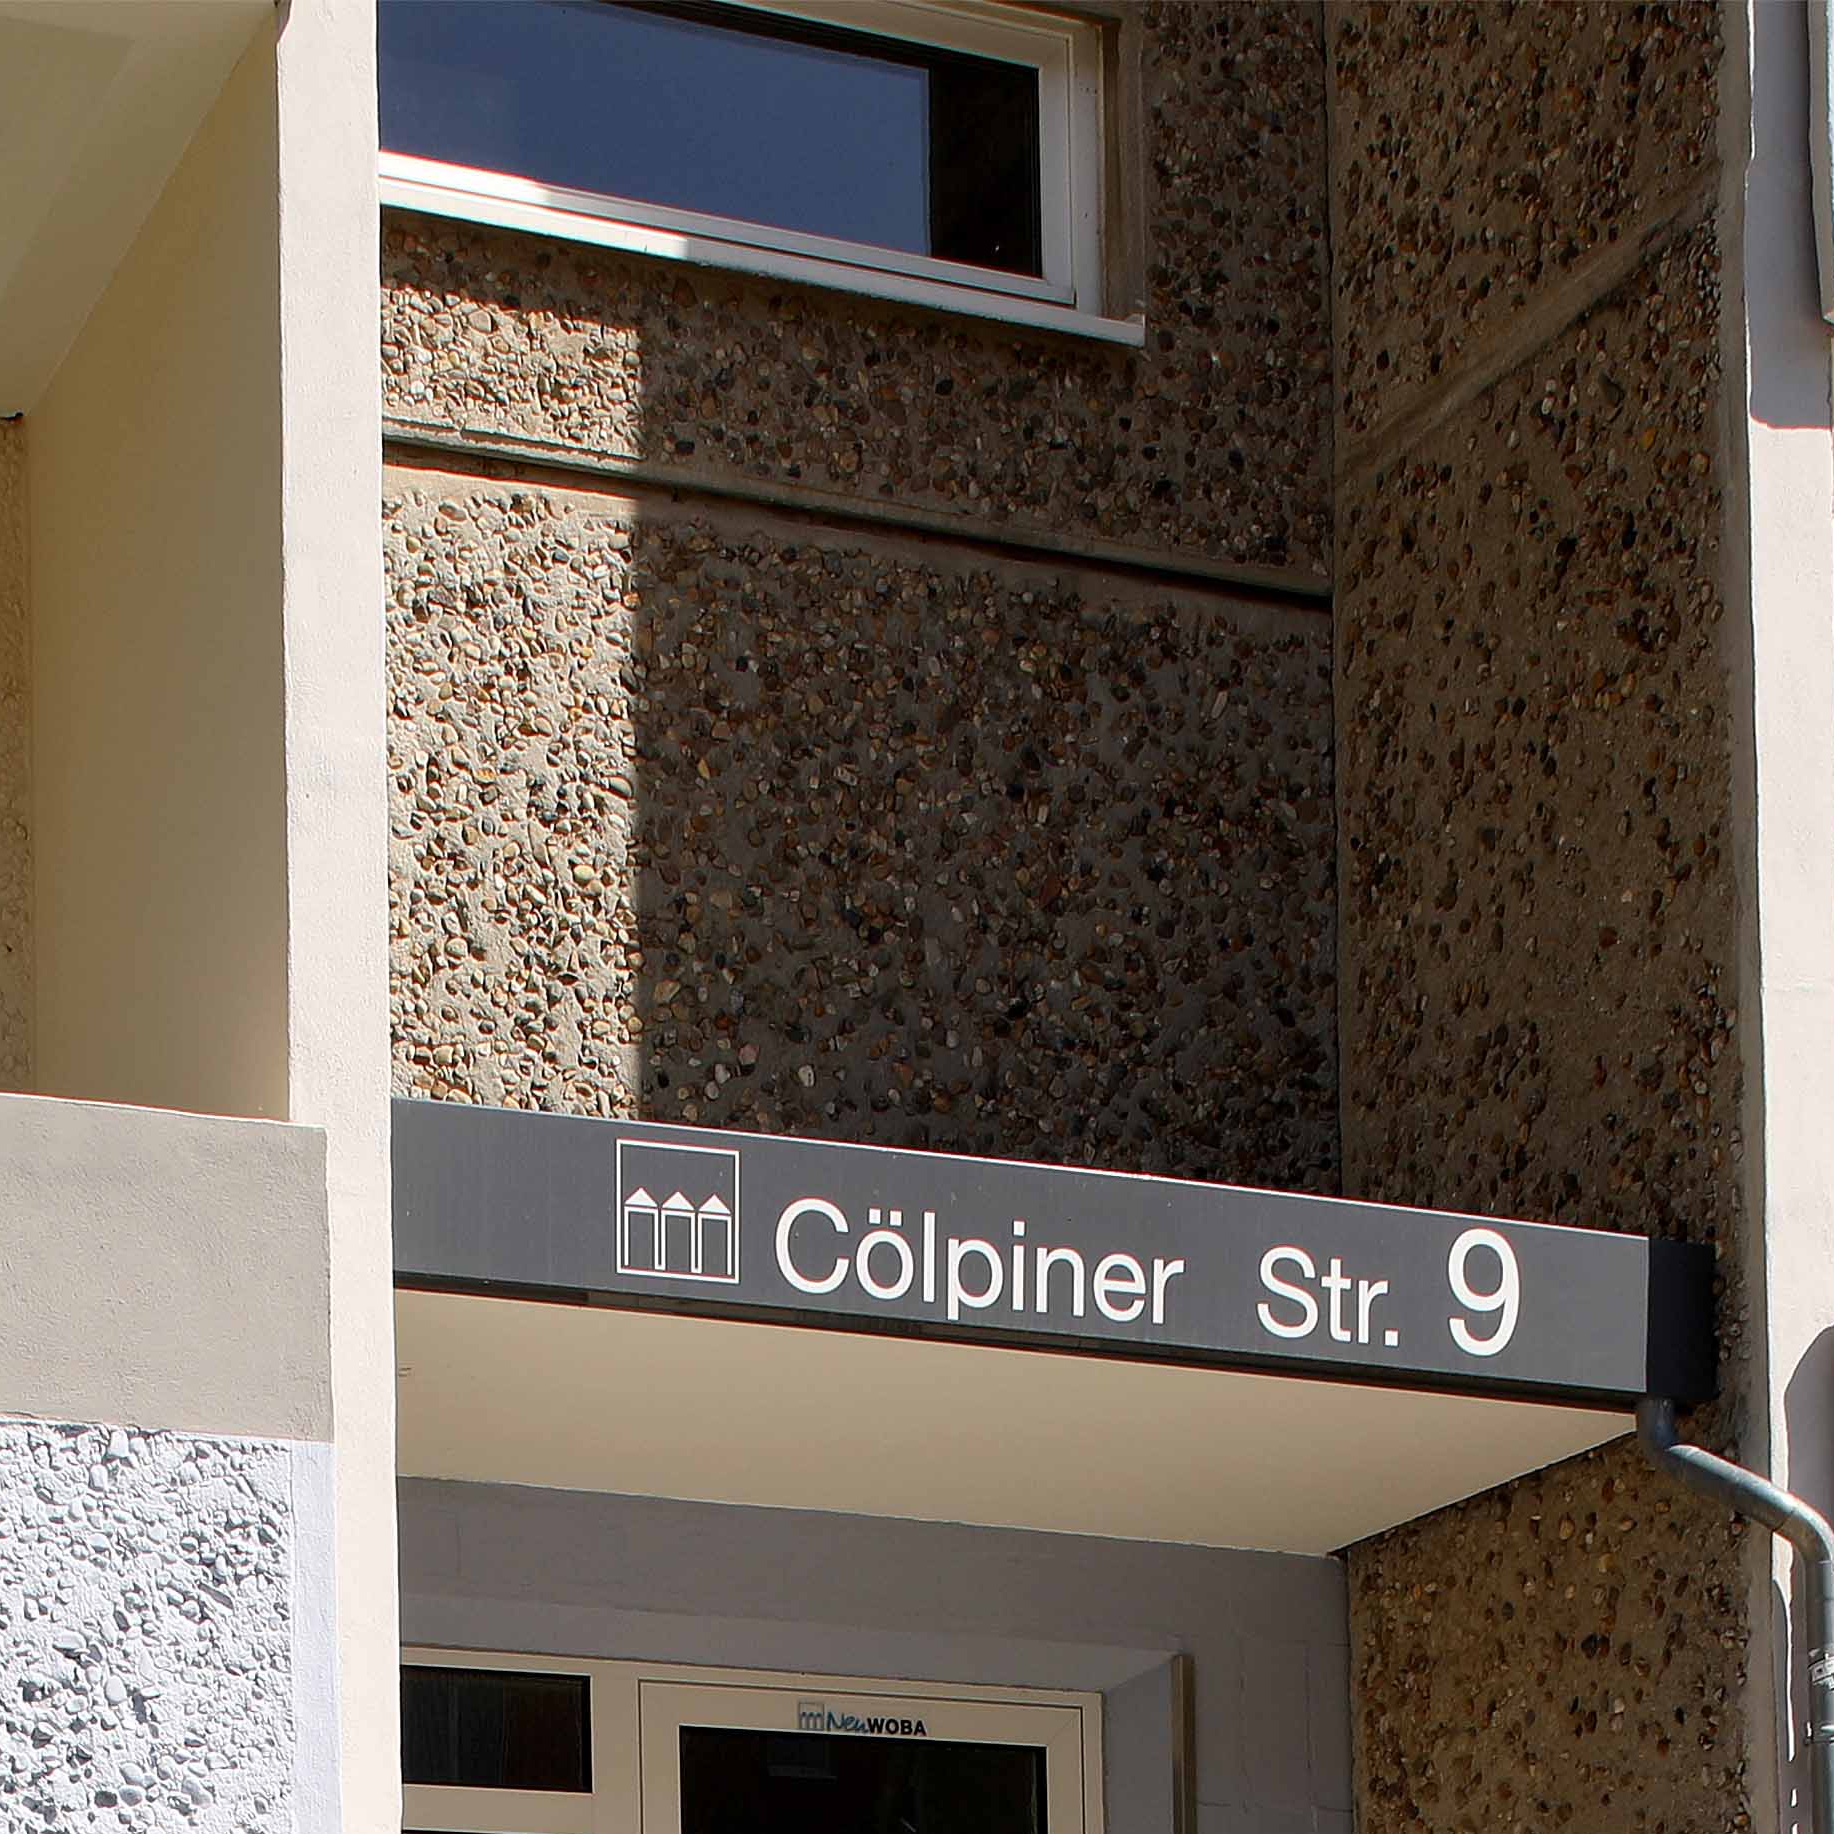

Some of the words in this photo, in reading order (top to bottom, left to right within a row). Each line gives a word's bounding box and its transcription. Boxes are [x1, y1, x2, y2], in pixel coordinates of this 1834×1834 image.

[775, 1198, 1185, 1322] Cölpiner
[1257, 1246, 1399, 1347] Str.
[1448, 1228, 1520, 1356] 9
